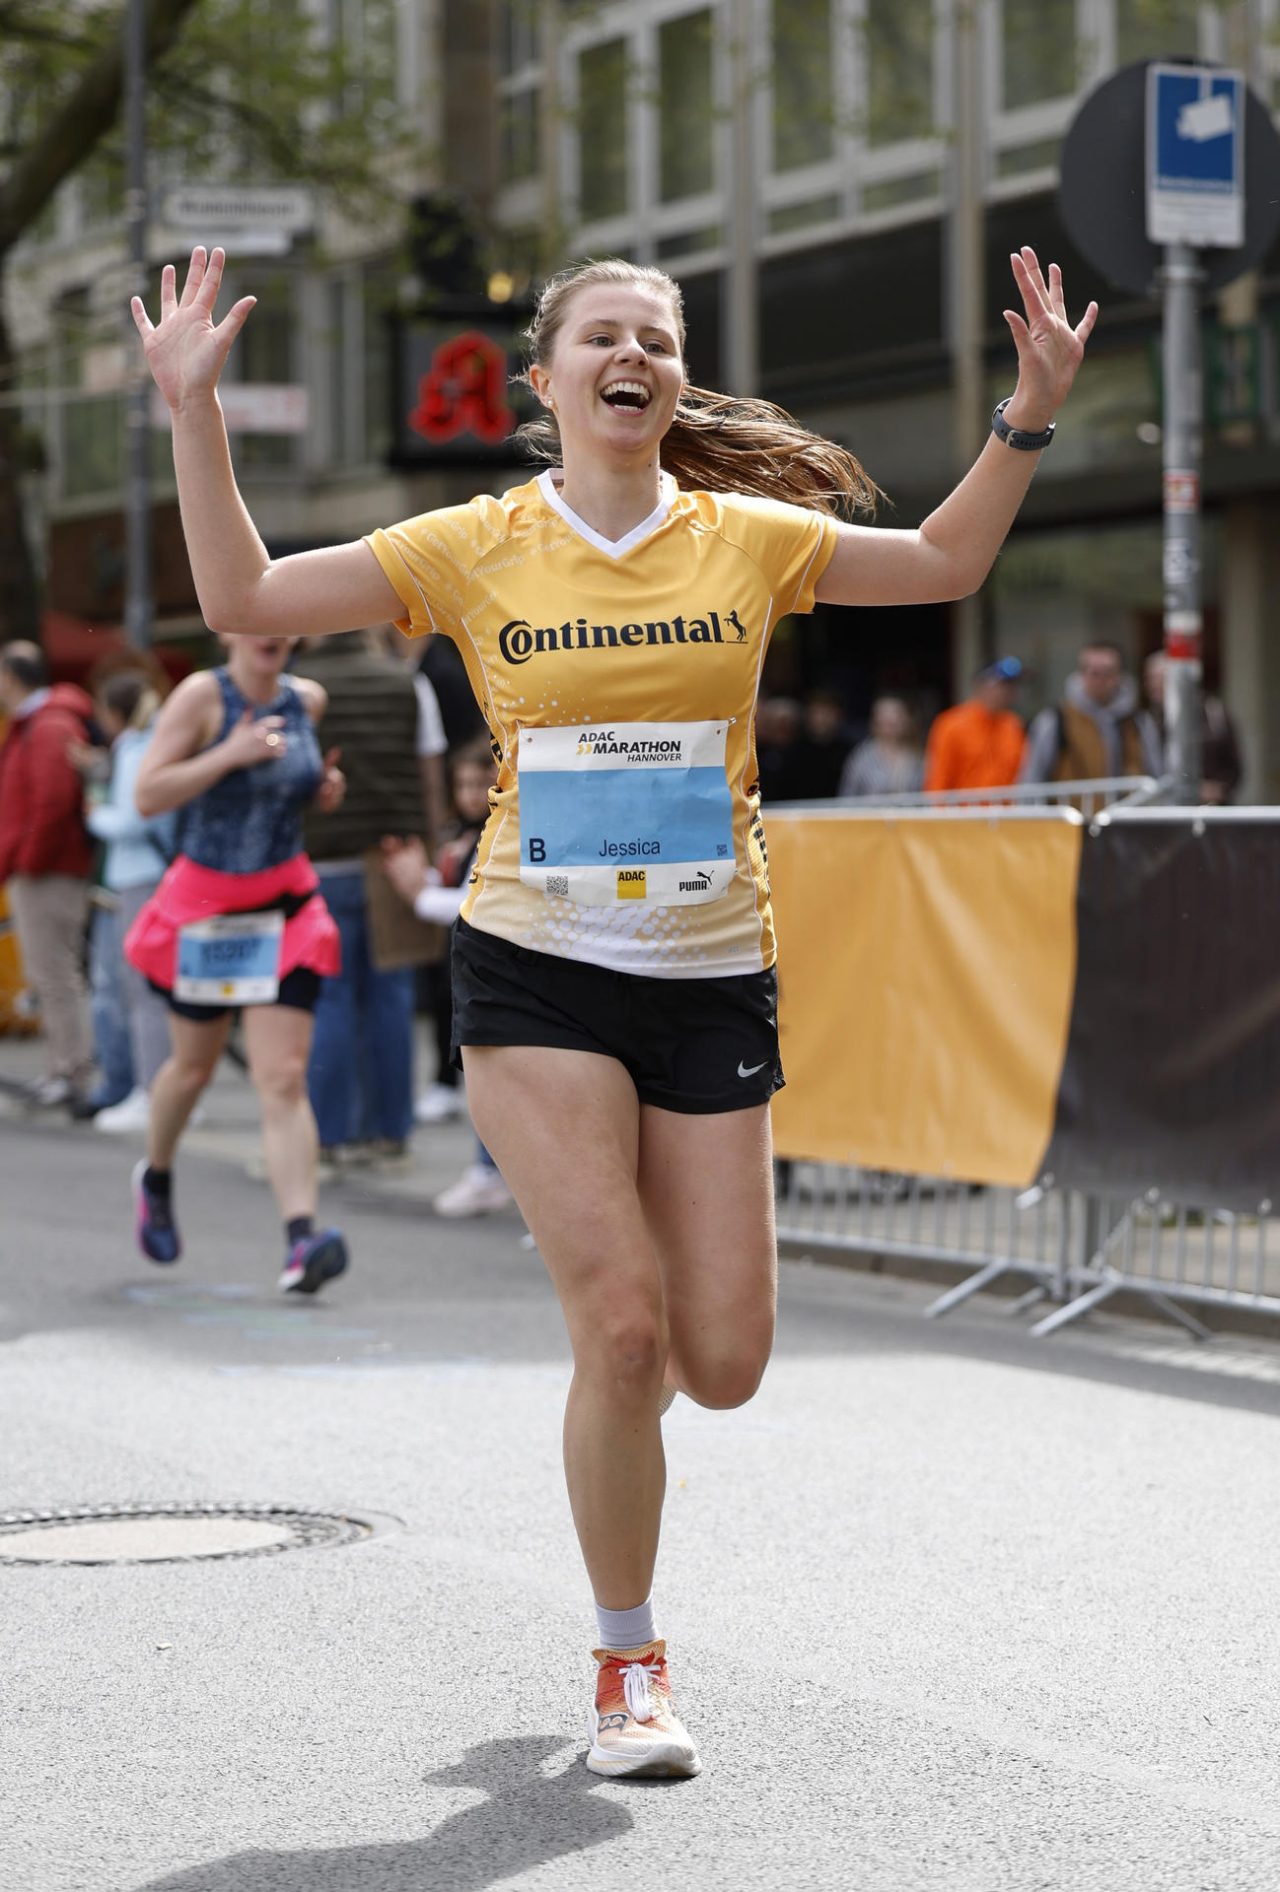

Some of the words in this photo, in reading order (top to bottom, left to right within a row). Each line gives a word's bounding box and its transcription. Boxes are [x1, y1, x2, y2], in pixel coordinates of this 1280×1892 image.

[499, 612, 724, 665] Continental
[578, 731, 615, 743] ADAC
[593, 740, 681, 754] MARATHON
[627, 753, 682, 762] HANNOVER
[529, 838, 546, 862] B
[599, 838, 661, 857] Jessica
[618, 870, 646, 882] ADAC
[679, 880, 707, 892] PUMA
